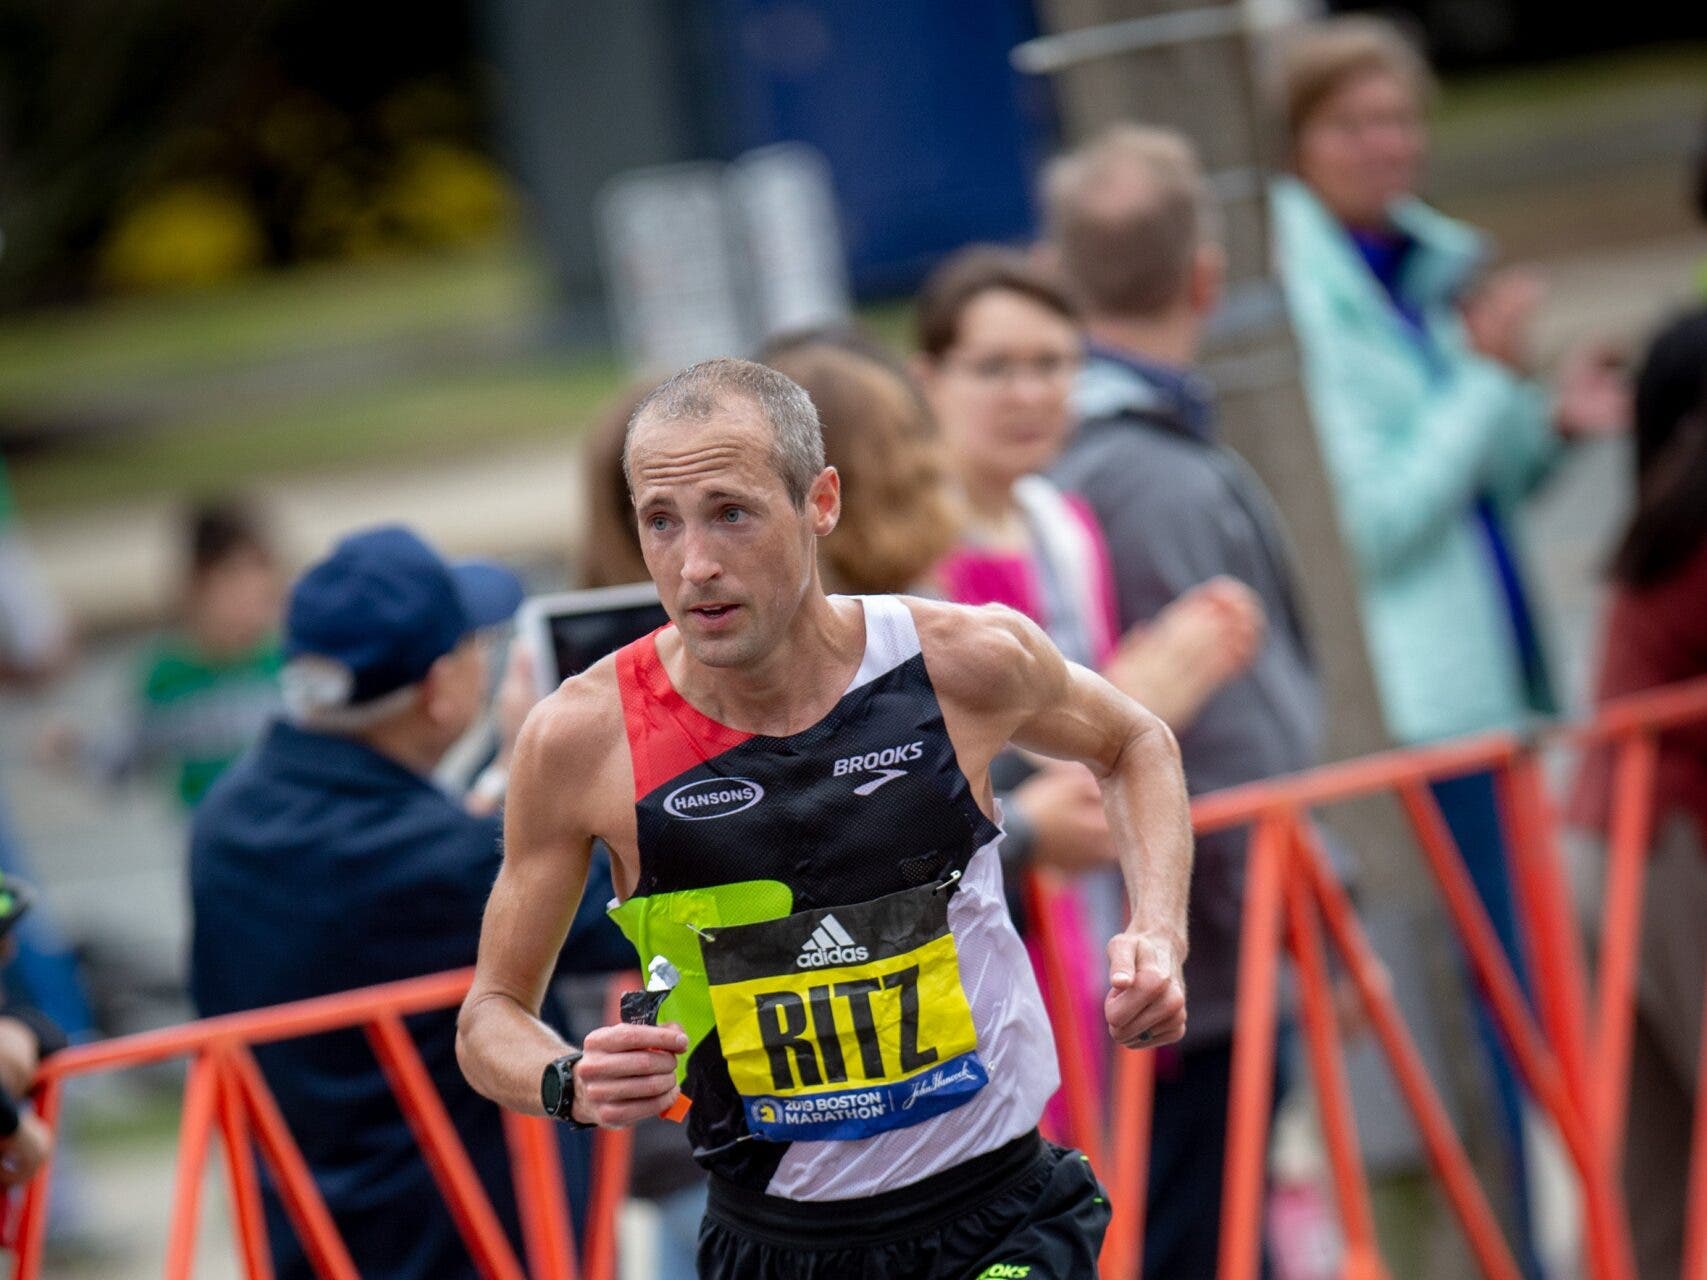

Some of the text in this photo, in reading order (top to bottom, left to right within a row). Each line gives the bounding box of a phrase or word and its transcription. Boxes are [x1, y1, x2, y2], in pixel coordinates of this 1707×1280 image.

[833, 741, 924, 777] BROOKS
[674, 787, 754, 811] HANSONS
[796, 945, 869, 968] adidas
[754, 964, 938, 1090] RITZ
[784, 1099, 814, 1112] 2019
[815, 1091, 882, 1111] BOSTON
[785, 1104, 884, 1125] MARATHON
